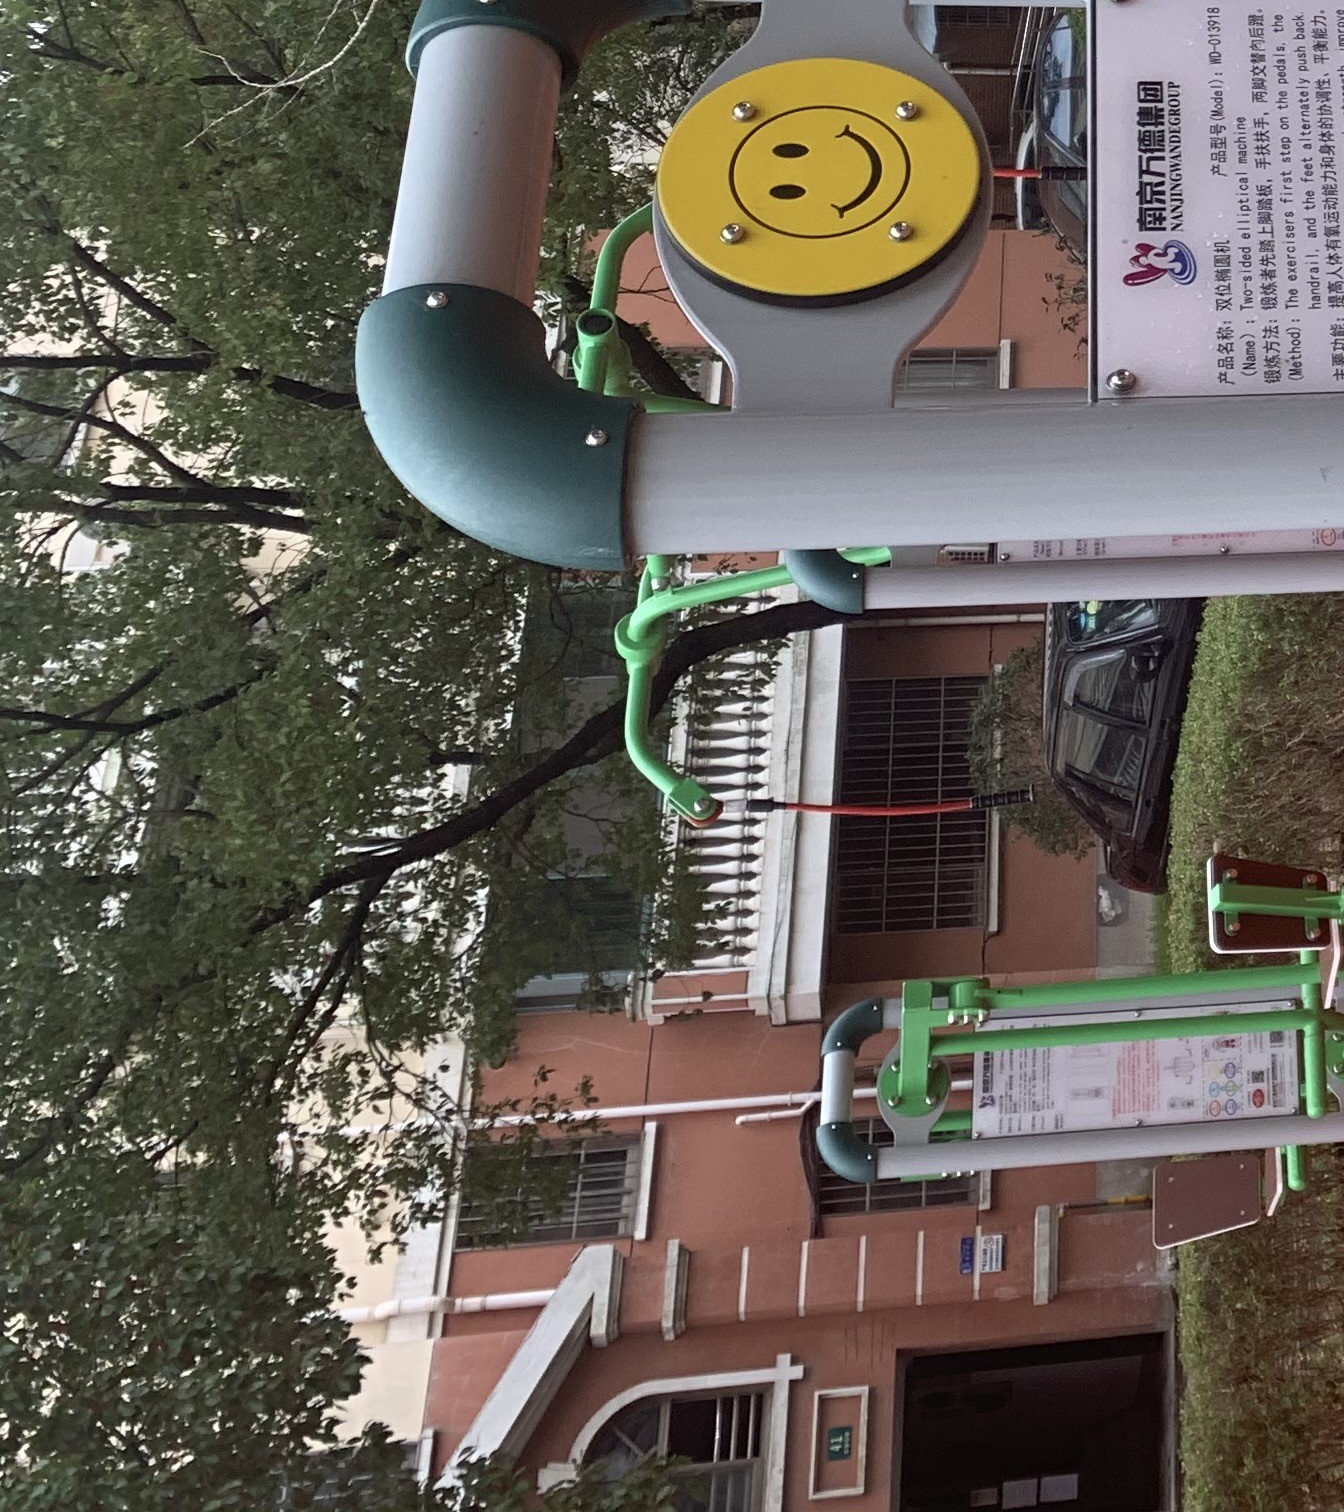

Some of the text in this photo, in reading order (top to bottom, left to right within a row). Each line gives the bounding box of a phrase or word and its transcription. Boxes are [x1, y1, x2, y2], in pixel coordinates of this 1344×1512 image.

[1207, 7, 1222, 64] WD-013918
[1271, 14, 1284, 33] the
[1273, 42, 1290, 84] pedals,
[1294, 46, 1309, 71] push
[1276, 91, 1288, 110] the
[1296, 78, 1312, 150] alternately
[1235, 117, 1248, 164] machine
[1279, 116, 1289, 130] on
[1136, 81, 1167, 232] 南京万德集团
[1167, 81, 1185, 232] NANJINGWANDEGROUP
[1279, 136, 1293, 162] step
[1279, 170, 1294, 204] first
[1301, 157, 1314, 183] feet
[1235, 172, 1252, 240] elliptical
[1301, 190, 1316, 210] the
[1283, 211, 1298, 281] exercisers
[1304, 218, 1317, 238] and
[1214, 240, 1232, 311] 双位椭圆机
[1238, 246, 1253, 311] Two-sided
[1305, 249, 1321, 309] handrail,
[1285, 289, 1299, 309] The
[829, 1435, 843, 1452] 41
